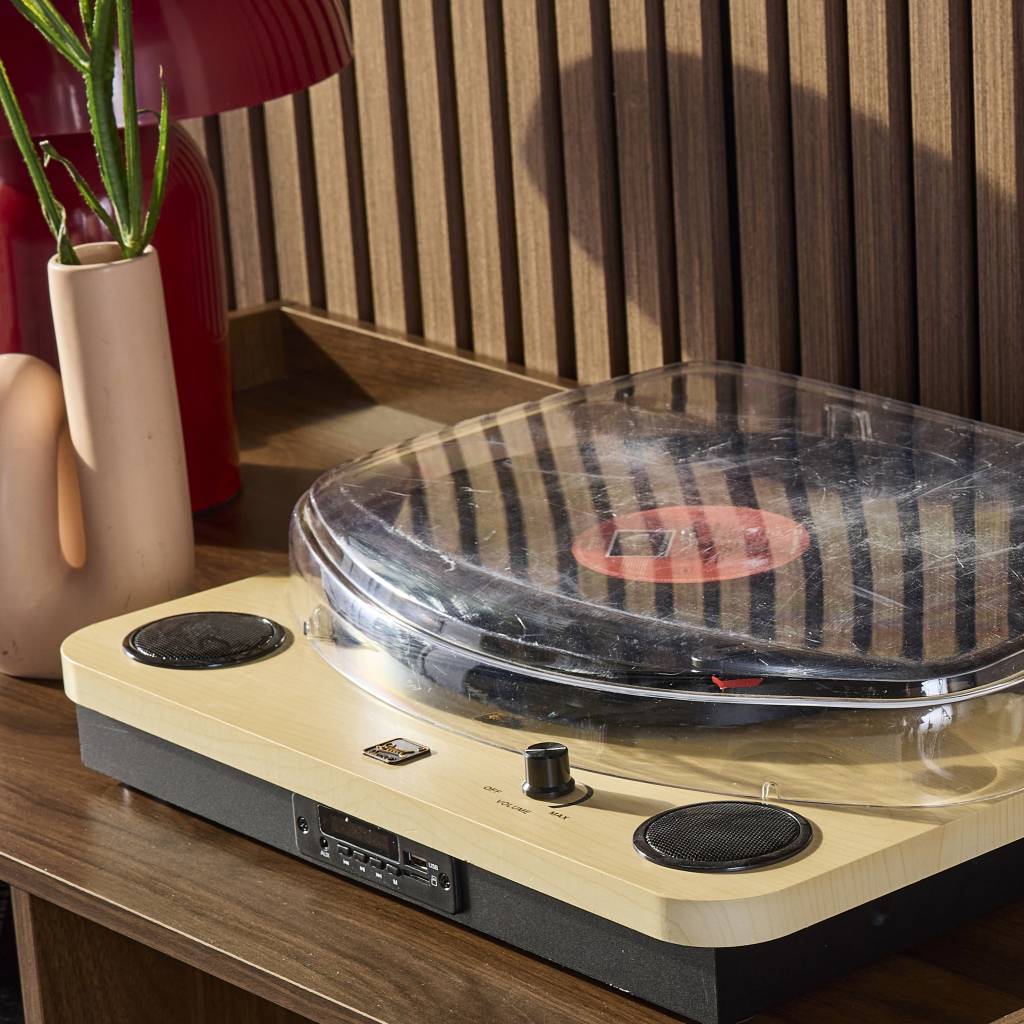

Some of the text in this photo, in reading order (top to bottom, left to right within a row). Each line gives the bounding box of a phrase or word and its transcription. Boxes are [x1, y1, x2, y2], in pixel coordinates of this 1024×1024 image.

[496, 799, 532, 815] VOLUME
[549, 810, 570, 820] MAX
[428, 861, 439, 872] USB
